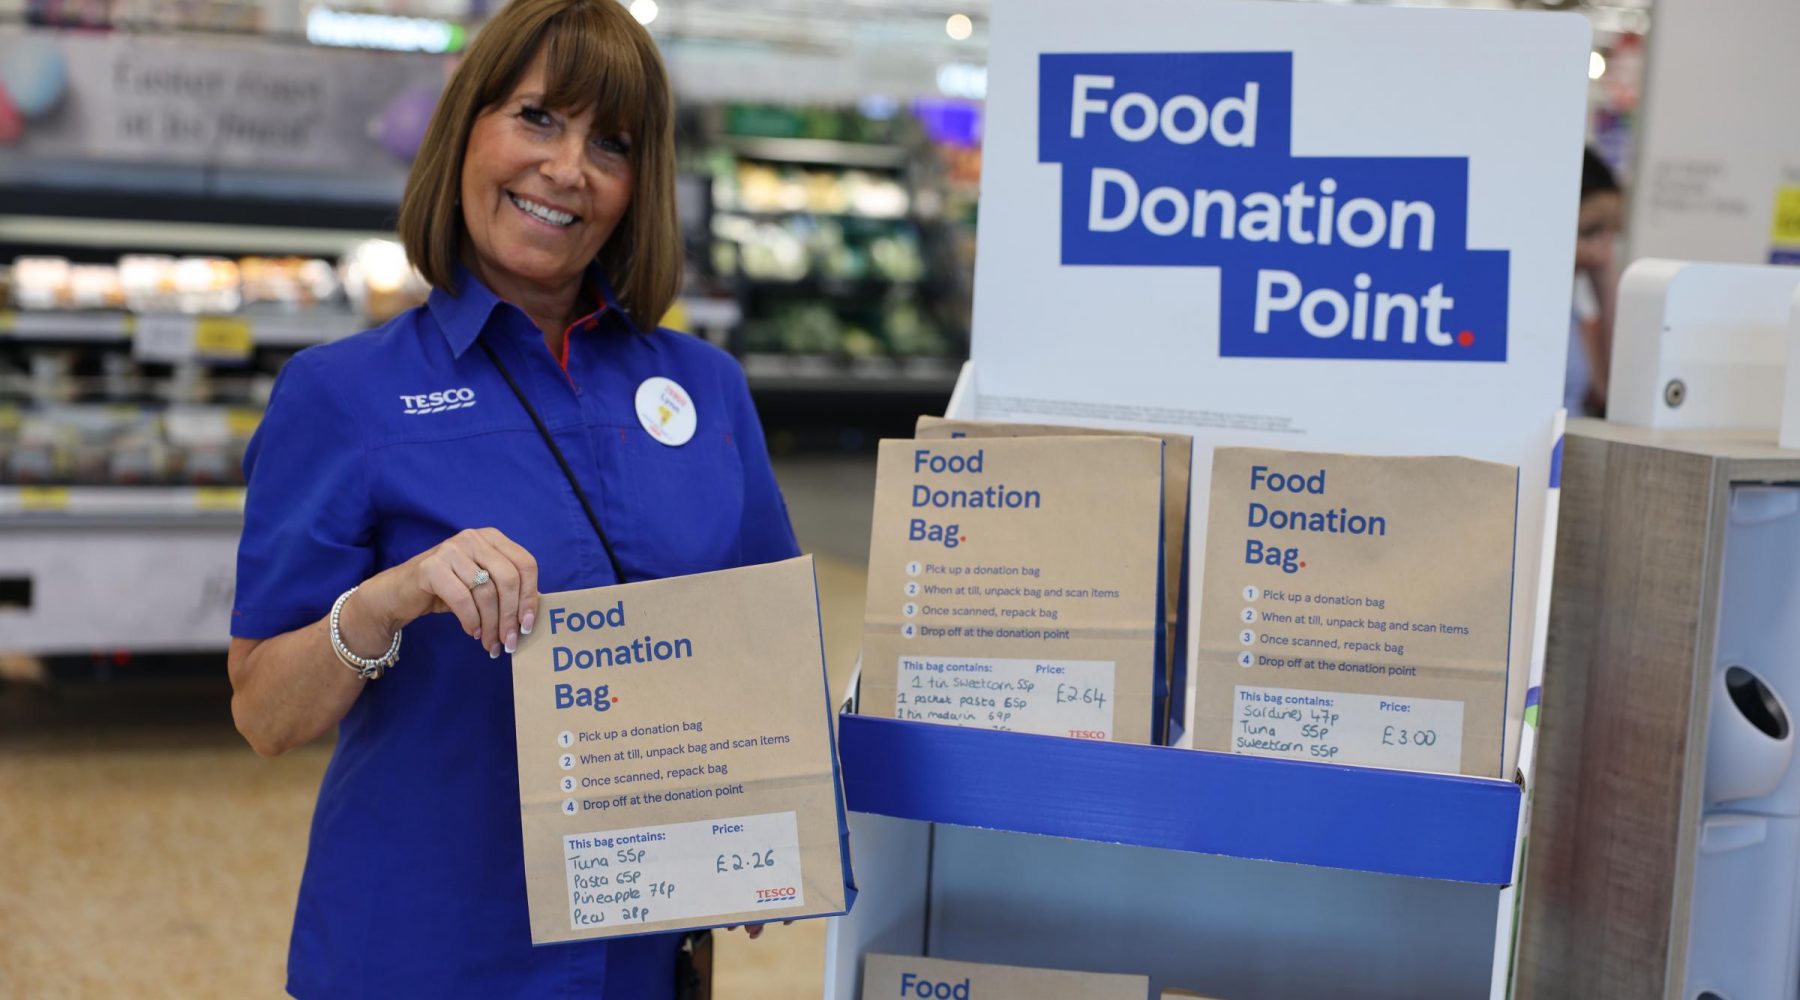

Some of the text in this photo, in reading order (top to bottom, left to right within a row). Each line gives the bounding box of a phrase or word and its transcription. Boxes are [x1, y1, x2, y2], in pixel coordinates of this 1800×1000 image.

[1070, 74, 1260, 148] Food
[1088, 167, 1436, 252] Donation
[1254, 269, 1475, 348] Point.
[400, 388, 475, 408] TESCO
[914, 449, 983, 473] Food
[1250, 466, 1326, 494] Food
[912, 484, 1040, 508] Donation
[1248, 502, 1386, 536] Donation
[909, 518, 966, 548] Bag.
[1245, 539, 1306, 574] Bag.
[926, 564, 946, 574] Pick
[949, 567, 962, 576] up
[974, 566, 1018, 575] donation
[1022, 566, 1040, 578] bag
[924, 585, 952, 594] When
[955, 586, 964, 594] at
[968, 586, 982, 596] till,
[985, 587, 1020, 596] unpack
[1024, 588, 1042, 598] bag
[1044, 588, 1062, 596] and
[1092, 588, 1120, 598] items
[1264, 590, 1285, 600] Pick
[1288, 594, 1302, 602] up
[1314, 594, 1362, 606] donation
[1366, 597, 1384, 610] bag
[549, 600, 626, 634] Food
[922, 606, 949, 615] Once
[952, 608, 998, 616] scanned,
[1002, 608, 1036, 618] repack
[1039, 608, 1058, 620] bag
[1262, 612, 1292, 622] When
[1295, 616, 1305, 624] at
[1308, 616, 1322, 626] till,
[1326, 618, 1364, 628] unpack
[1368, 620, 1386, 632] bag
[1389, 622, 1409, 630] and
[1412, 624, 1436, 632] scan
[1440, 624, 1469, 634] items
[921, 626, 945, 638] Drop
[948, 627, 962, 636] off
[964, 628, 974, 636] at
[977, 628, 993, 636] the
[996, 628, 1040, 638] donation
[1044, 630, 1070, 640] point
[552, 636, 692, 672] Donation
[1260, 634, 1288, 644] Once
[1292, 638, 1340, 650] scanned,
[1344, 642, 1381, 652] repack
[1384, 642, 1404, 656] bag
[904, 661, 992, 673] This bag contains:
[1036, 664, 1065, 674] Price:
[1259, 656, 1284, 668] Drop
[1287, 658, 1302, 668] off
[1304, 660, 1314, 669] at
[1318, 660, 1336, 670] the
[1338, 662, 1386, 674] donation
[1388, 666, 1416, 676] point
[912, 676, 922, 688] 1
[928, 676, 949, 688] tin
[1017, 679, 1035, 692] 55p
[554, 684, 618, 712] Bag.
[898, 692, 907, 704] 1
[960, 696, 995, 708] pasta
[1004, 697, 1027, 710] 65p
[1056, 683, 1107, 708] £2.64
[1240, 692, 1334, 706] This bag contains:
[898, 708, 904, 718] 1
[908, 710, 922, 719] tin
[988, 711, 1012, 722] 69p
[1380, 701, 1410, 712] Price:
[1311, 710, 1340, 726] 47p
[579, 731, 600, 742] Pick
[604, 731, 618, 740] up
[630, 724, 680, 736] donation
[682, 722, 702, 732] bag
[1068, 730, 1106, 739] TESCO
[1240, 720, 1328, 740] Tuna 55p
[1382, 726, 1436, 746] £3.00
[580, 754, 610, 764] When
[614, 752, 624, 760] at
[628, 750, 642, 759] till,
[646, 745, 684, 758] unpack
[688, 744, 707, 754] bag
[710, 740, 729, 750] and
[732, 738, 757, 748] scan
[760, 736, 790, 745] items
[1310, 744, 1338, 758] 55p
[582, 777, 610, 787] Once
[614, 770, 663, 784] scanned,
[667, 766, 704, 779] repack
[708, 764, 728, 774] bag
[584, 800, 610, 810] Drop
[613, 796, 627, 807] off
[630, 796, 640, 804] at
[644, 794, 662, 803] the
[664, 788, 712, 800] donation
[716, 784, 744, 798] point
[712, 824, 744, 834] Price:
[570, 832, 666, 850] This bag contains:
[568, 848, 646, 870] Tuna 55p
[716, 850, 774, 874] £2.26
[574, 871, 641, 888] Pasta 65p
[574, 881, 675, 904] Pineapple 78p
[756, 887, 796, 898] TESCO
[622, 906, 649, 922] 28p
[902, 973, 970, 1000] Food
